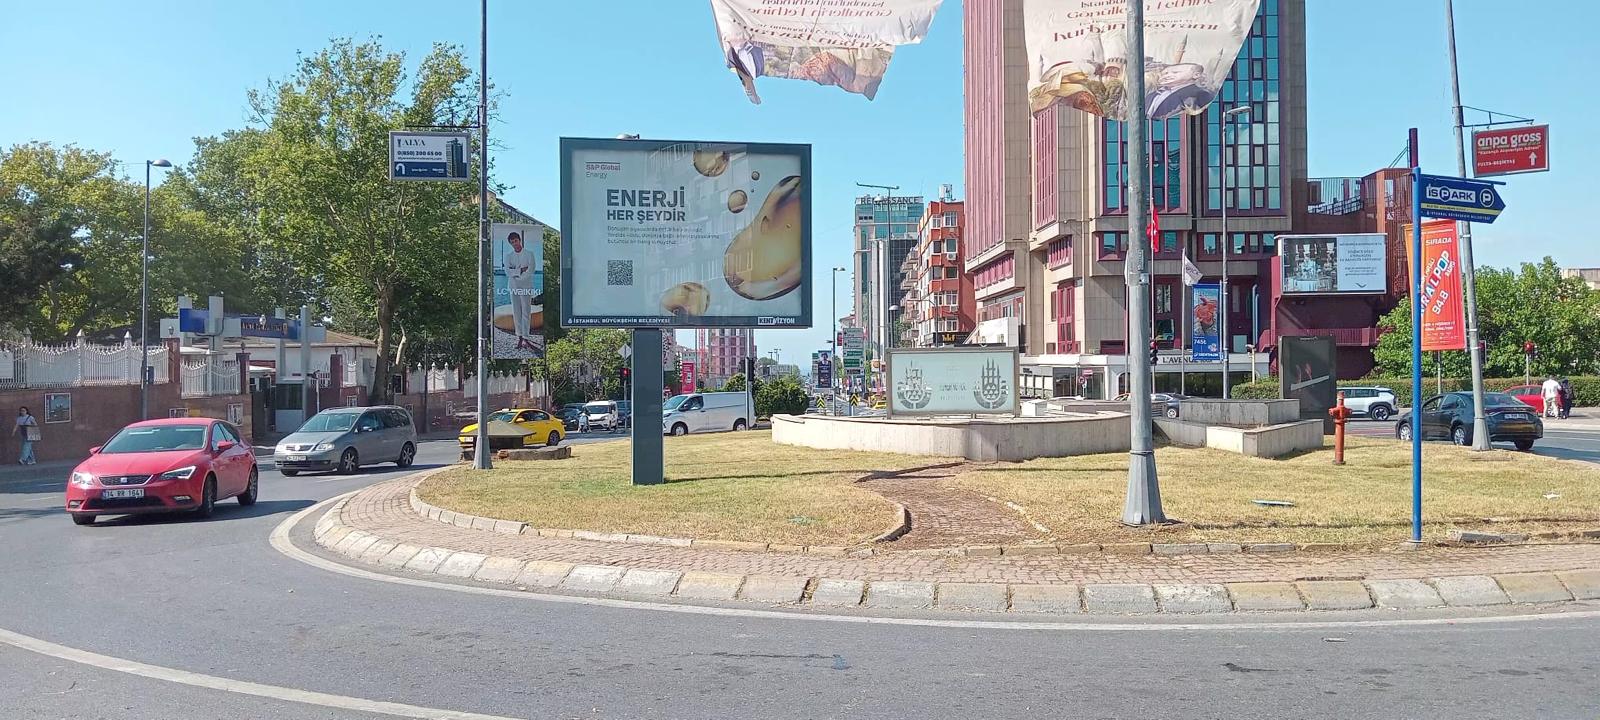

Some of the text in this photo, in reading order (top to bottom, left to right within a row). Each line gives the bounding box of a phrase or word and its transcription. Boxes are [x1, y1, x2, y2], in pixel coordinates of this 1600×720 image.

[1477, 132, 1542, 149] anpa gross
[586, 171, 608, 179] Energy
[606, 186, 685, 208] ENERJİ
[860, 196, 918, 205] RESSANCE
[606, 208, 686, 224] HER ŞEYDİR
[497, 288, 509, 296] LC
[638, 317, 670, 325] BELEDİYESİ
[1162, 356, 1198, 364] L'AVENU
